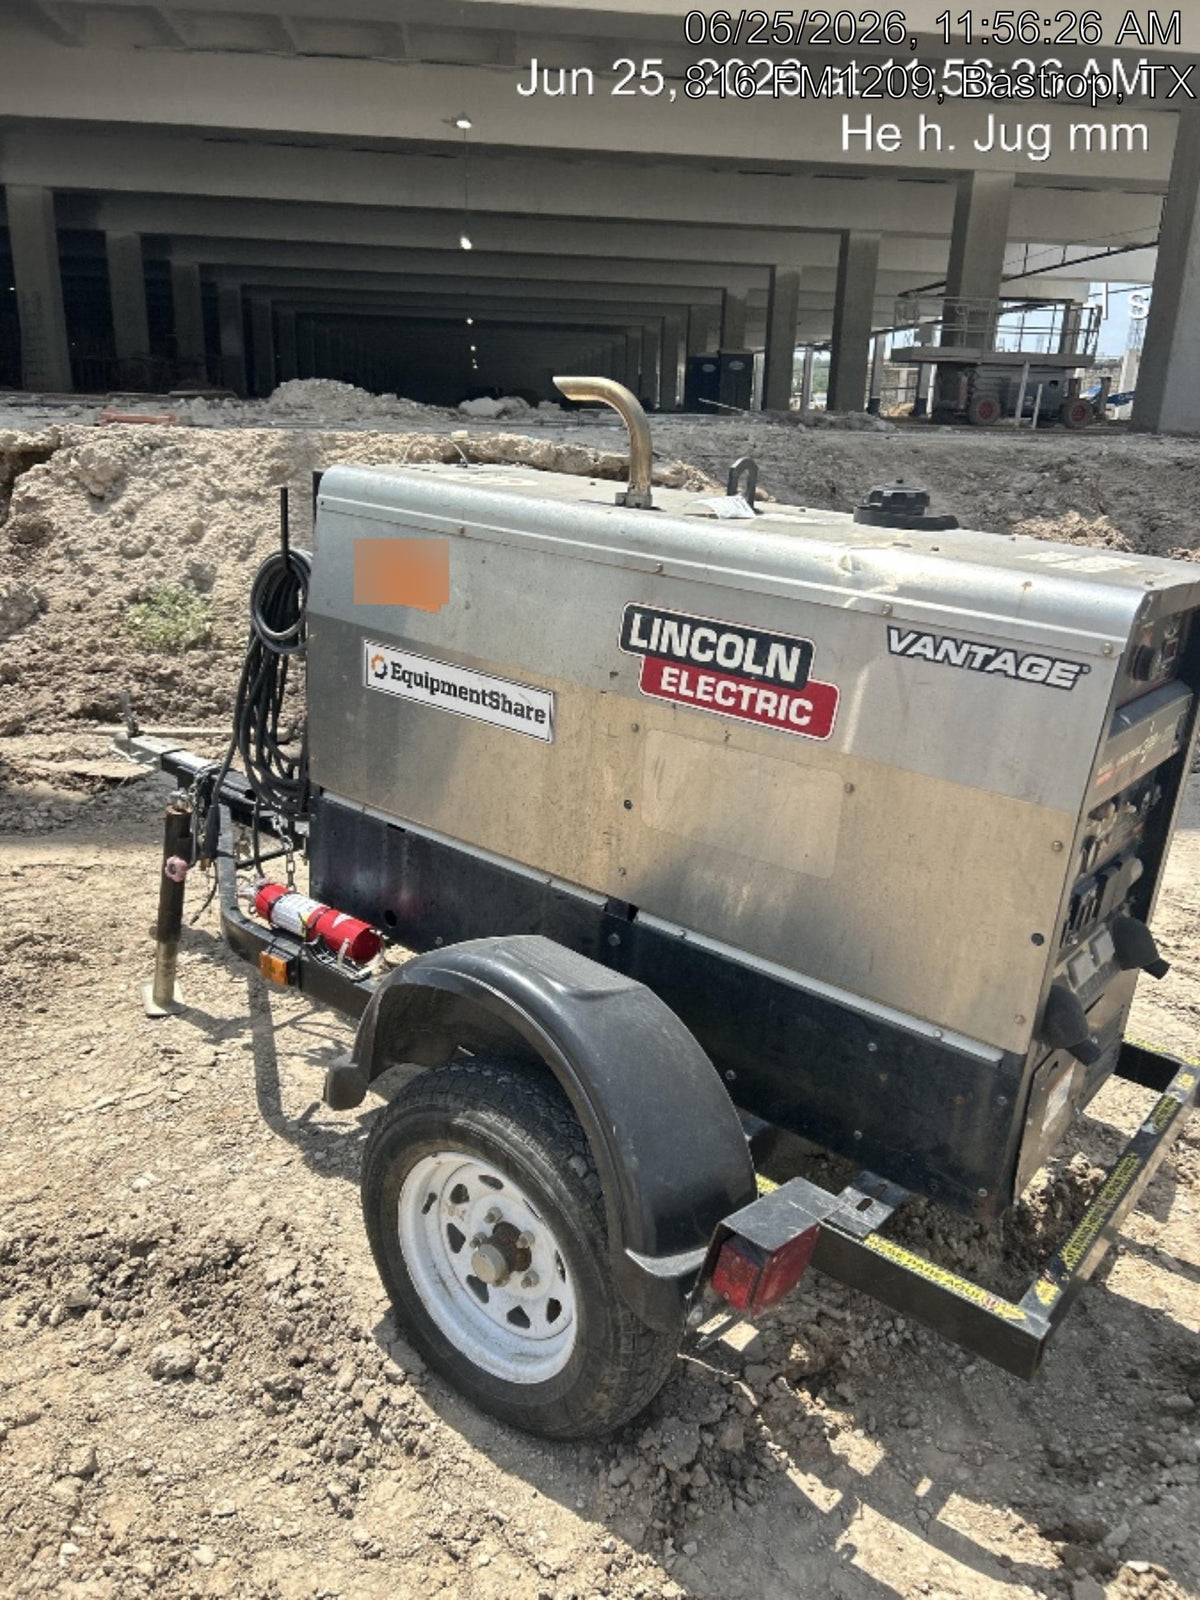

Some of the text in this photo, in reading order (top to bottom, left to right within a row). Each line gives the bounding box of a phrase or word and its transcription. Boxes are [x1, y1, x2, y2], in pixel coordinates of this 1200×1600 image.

[629, 612, 801, 684] LINCOLN
[887, 626, 1083, 690] VANTAGE
[391, 661, 546, 725] EquipmentShare
[660, 666, 814, 726] ELECTRIC
